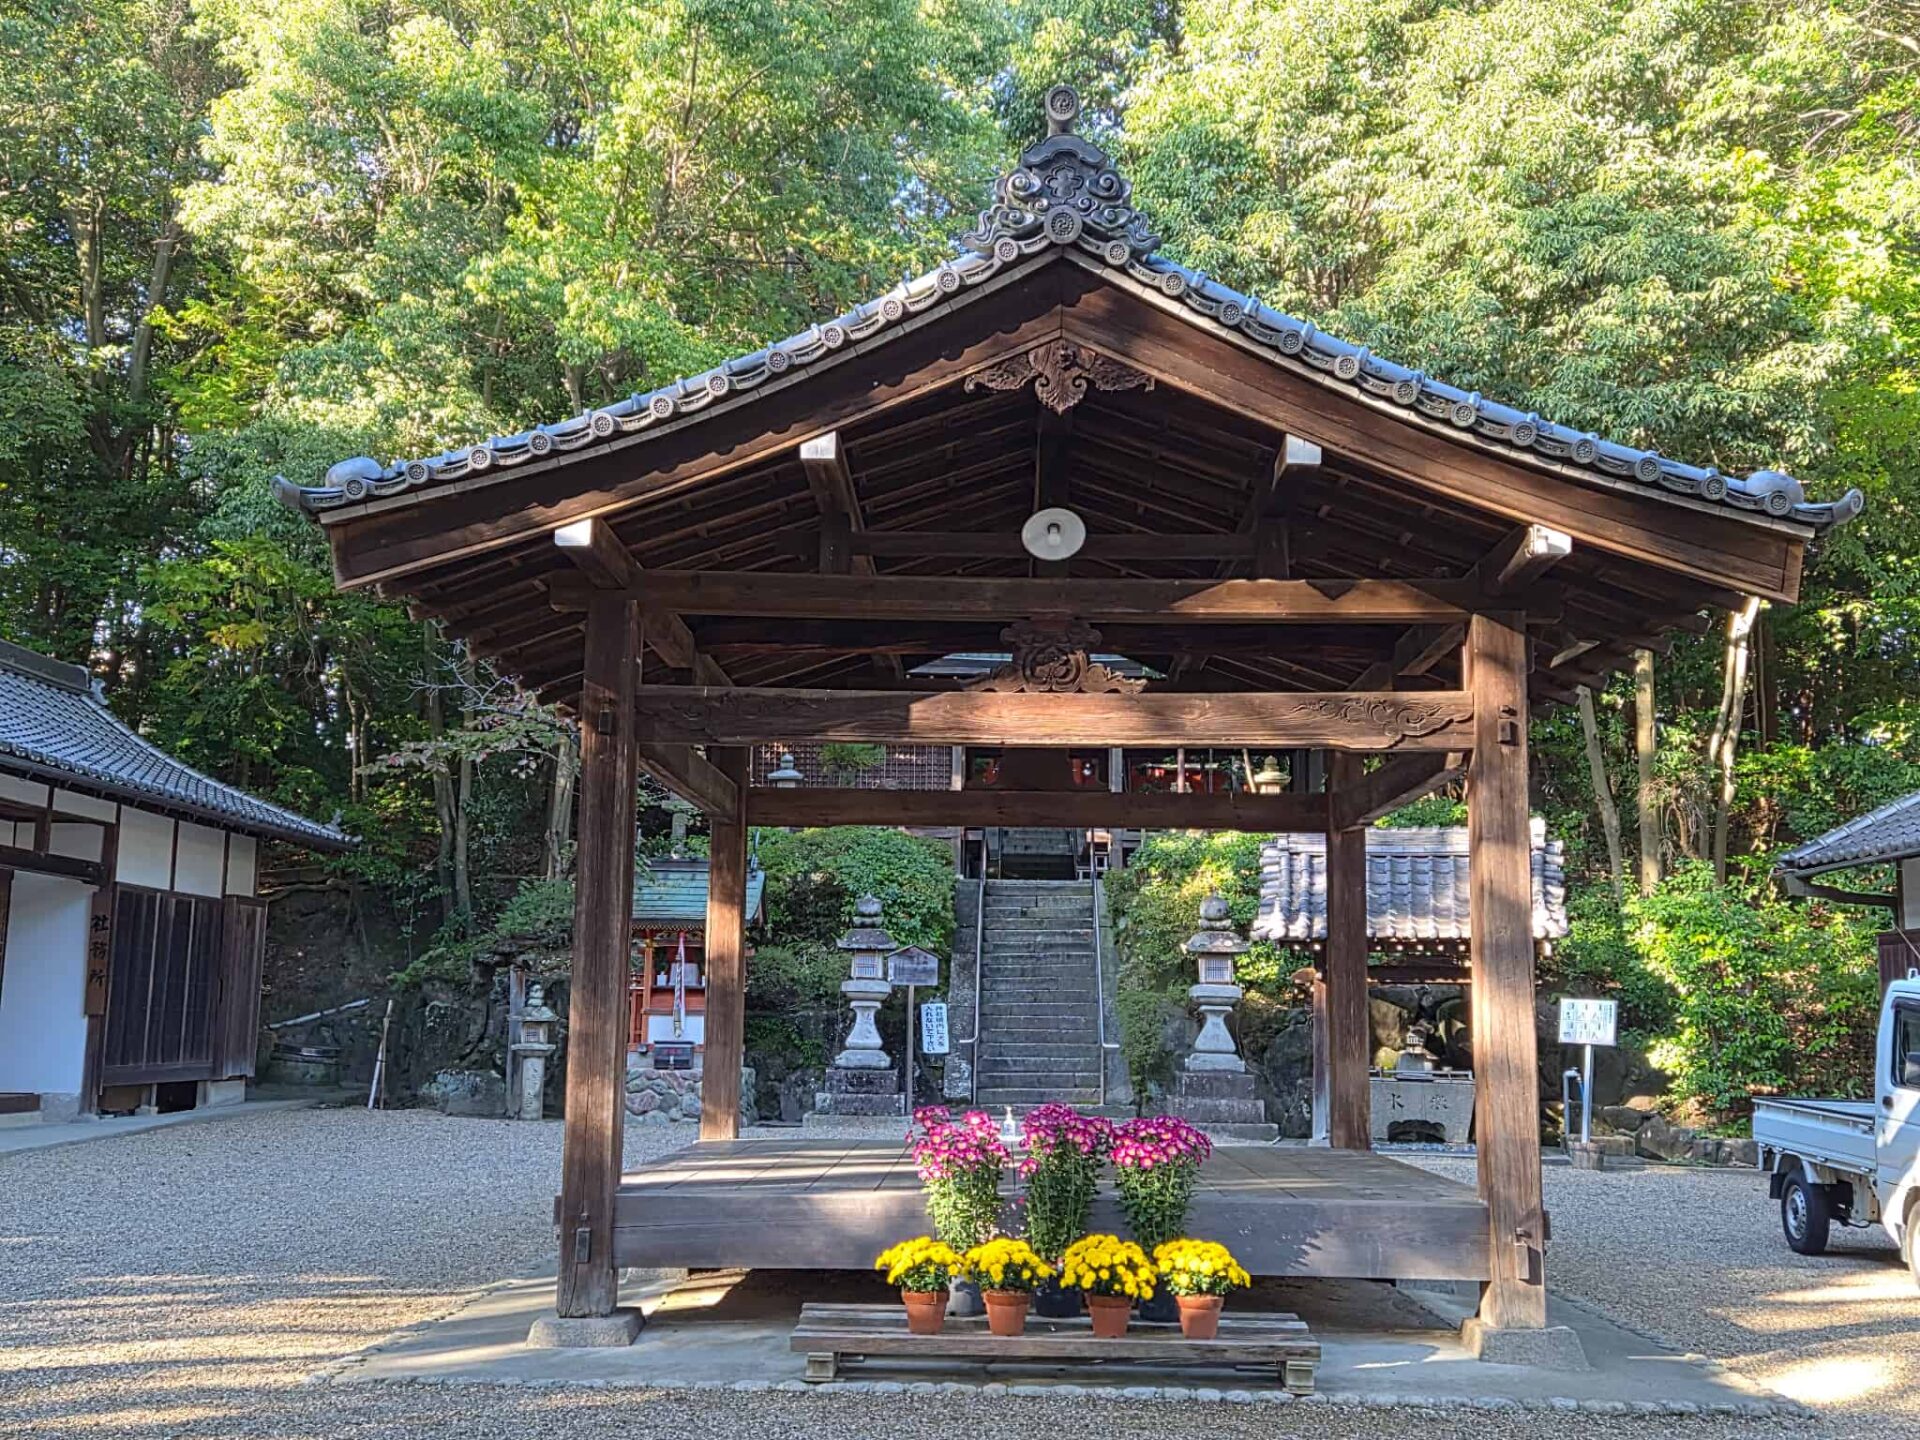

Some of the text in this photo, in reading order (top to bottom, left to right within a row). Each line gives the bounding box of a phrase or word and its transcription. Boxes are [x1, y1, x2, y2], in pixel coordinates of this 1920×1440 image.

[89, 914, 109, 987] 社務所
[924, 1005, 935, 1051] 入れないで下さい
